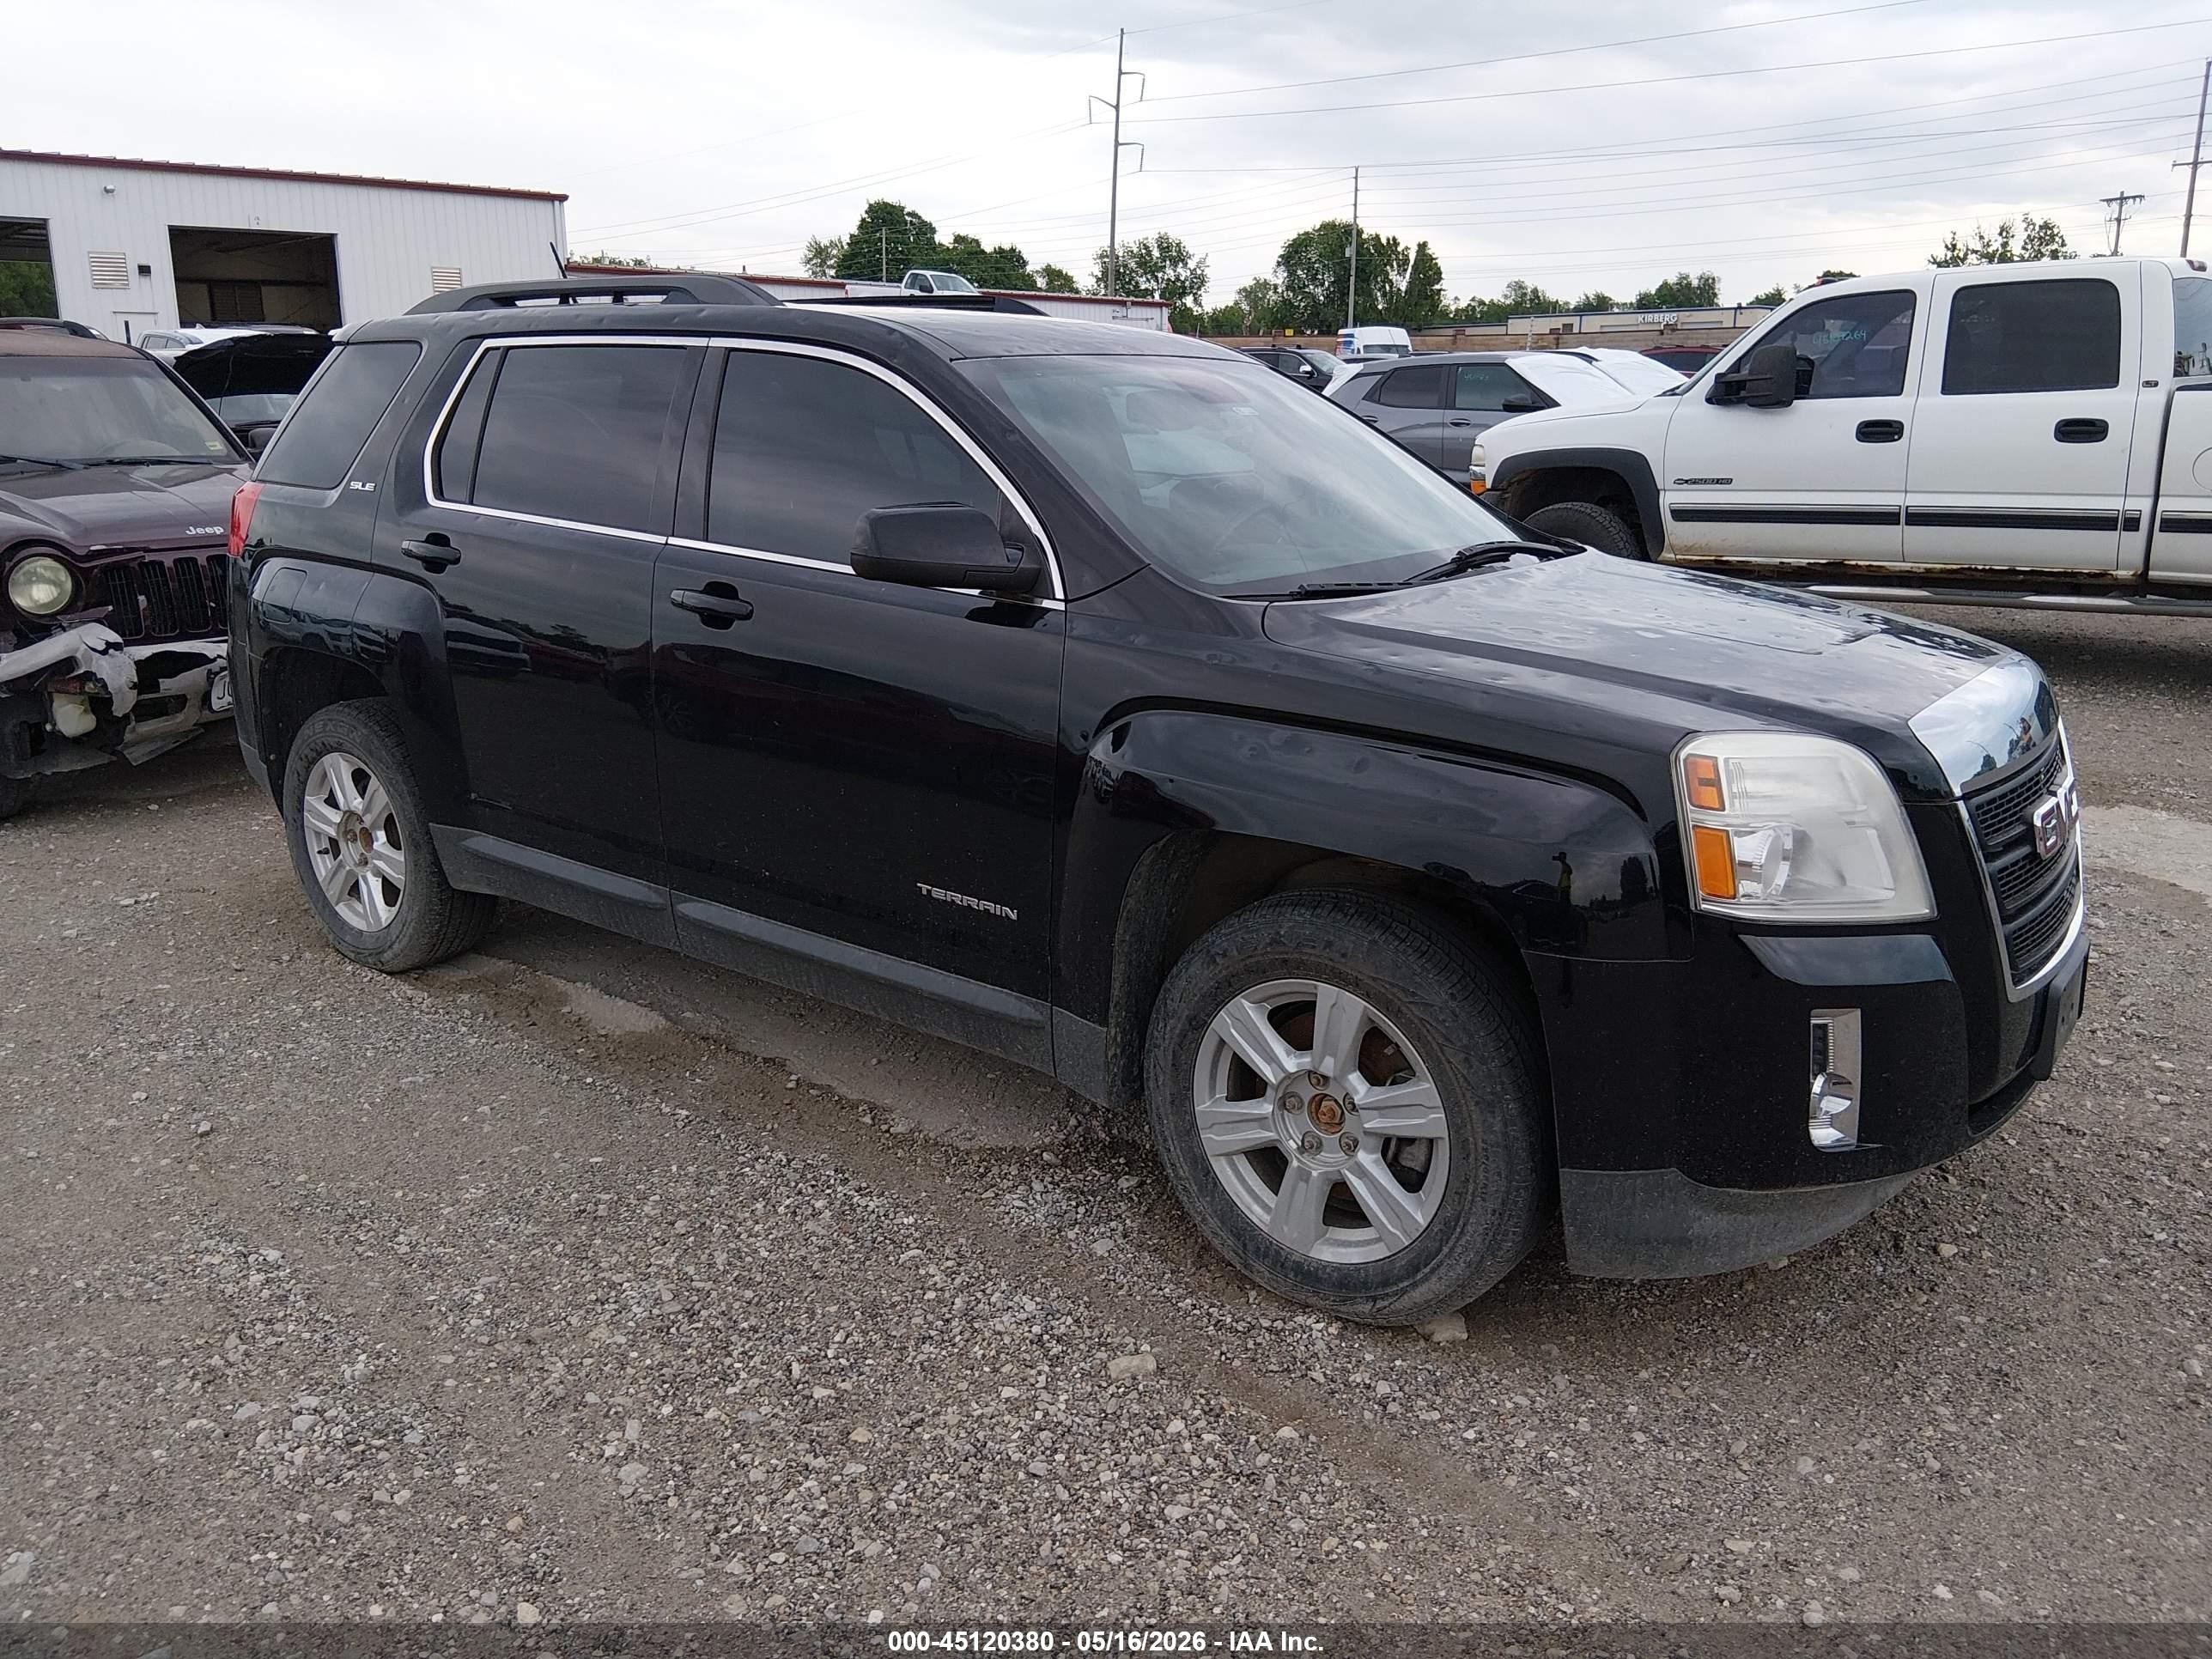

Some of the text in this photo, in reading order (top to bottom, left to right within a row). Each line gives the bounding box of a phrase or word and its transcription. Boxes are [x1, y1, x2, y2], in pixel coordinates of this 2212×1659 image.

[1638, 313, 1677, 324] KIRBERG
[349, 481, 375, 491] SLE
[185, 526, 224, 535] Jeep
[915, 882, 1018, 921] TERRAIN
